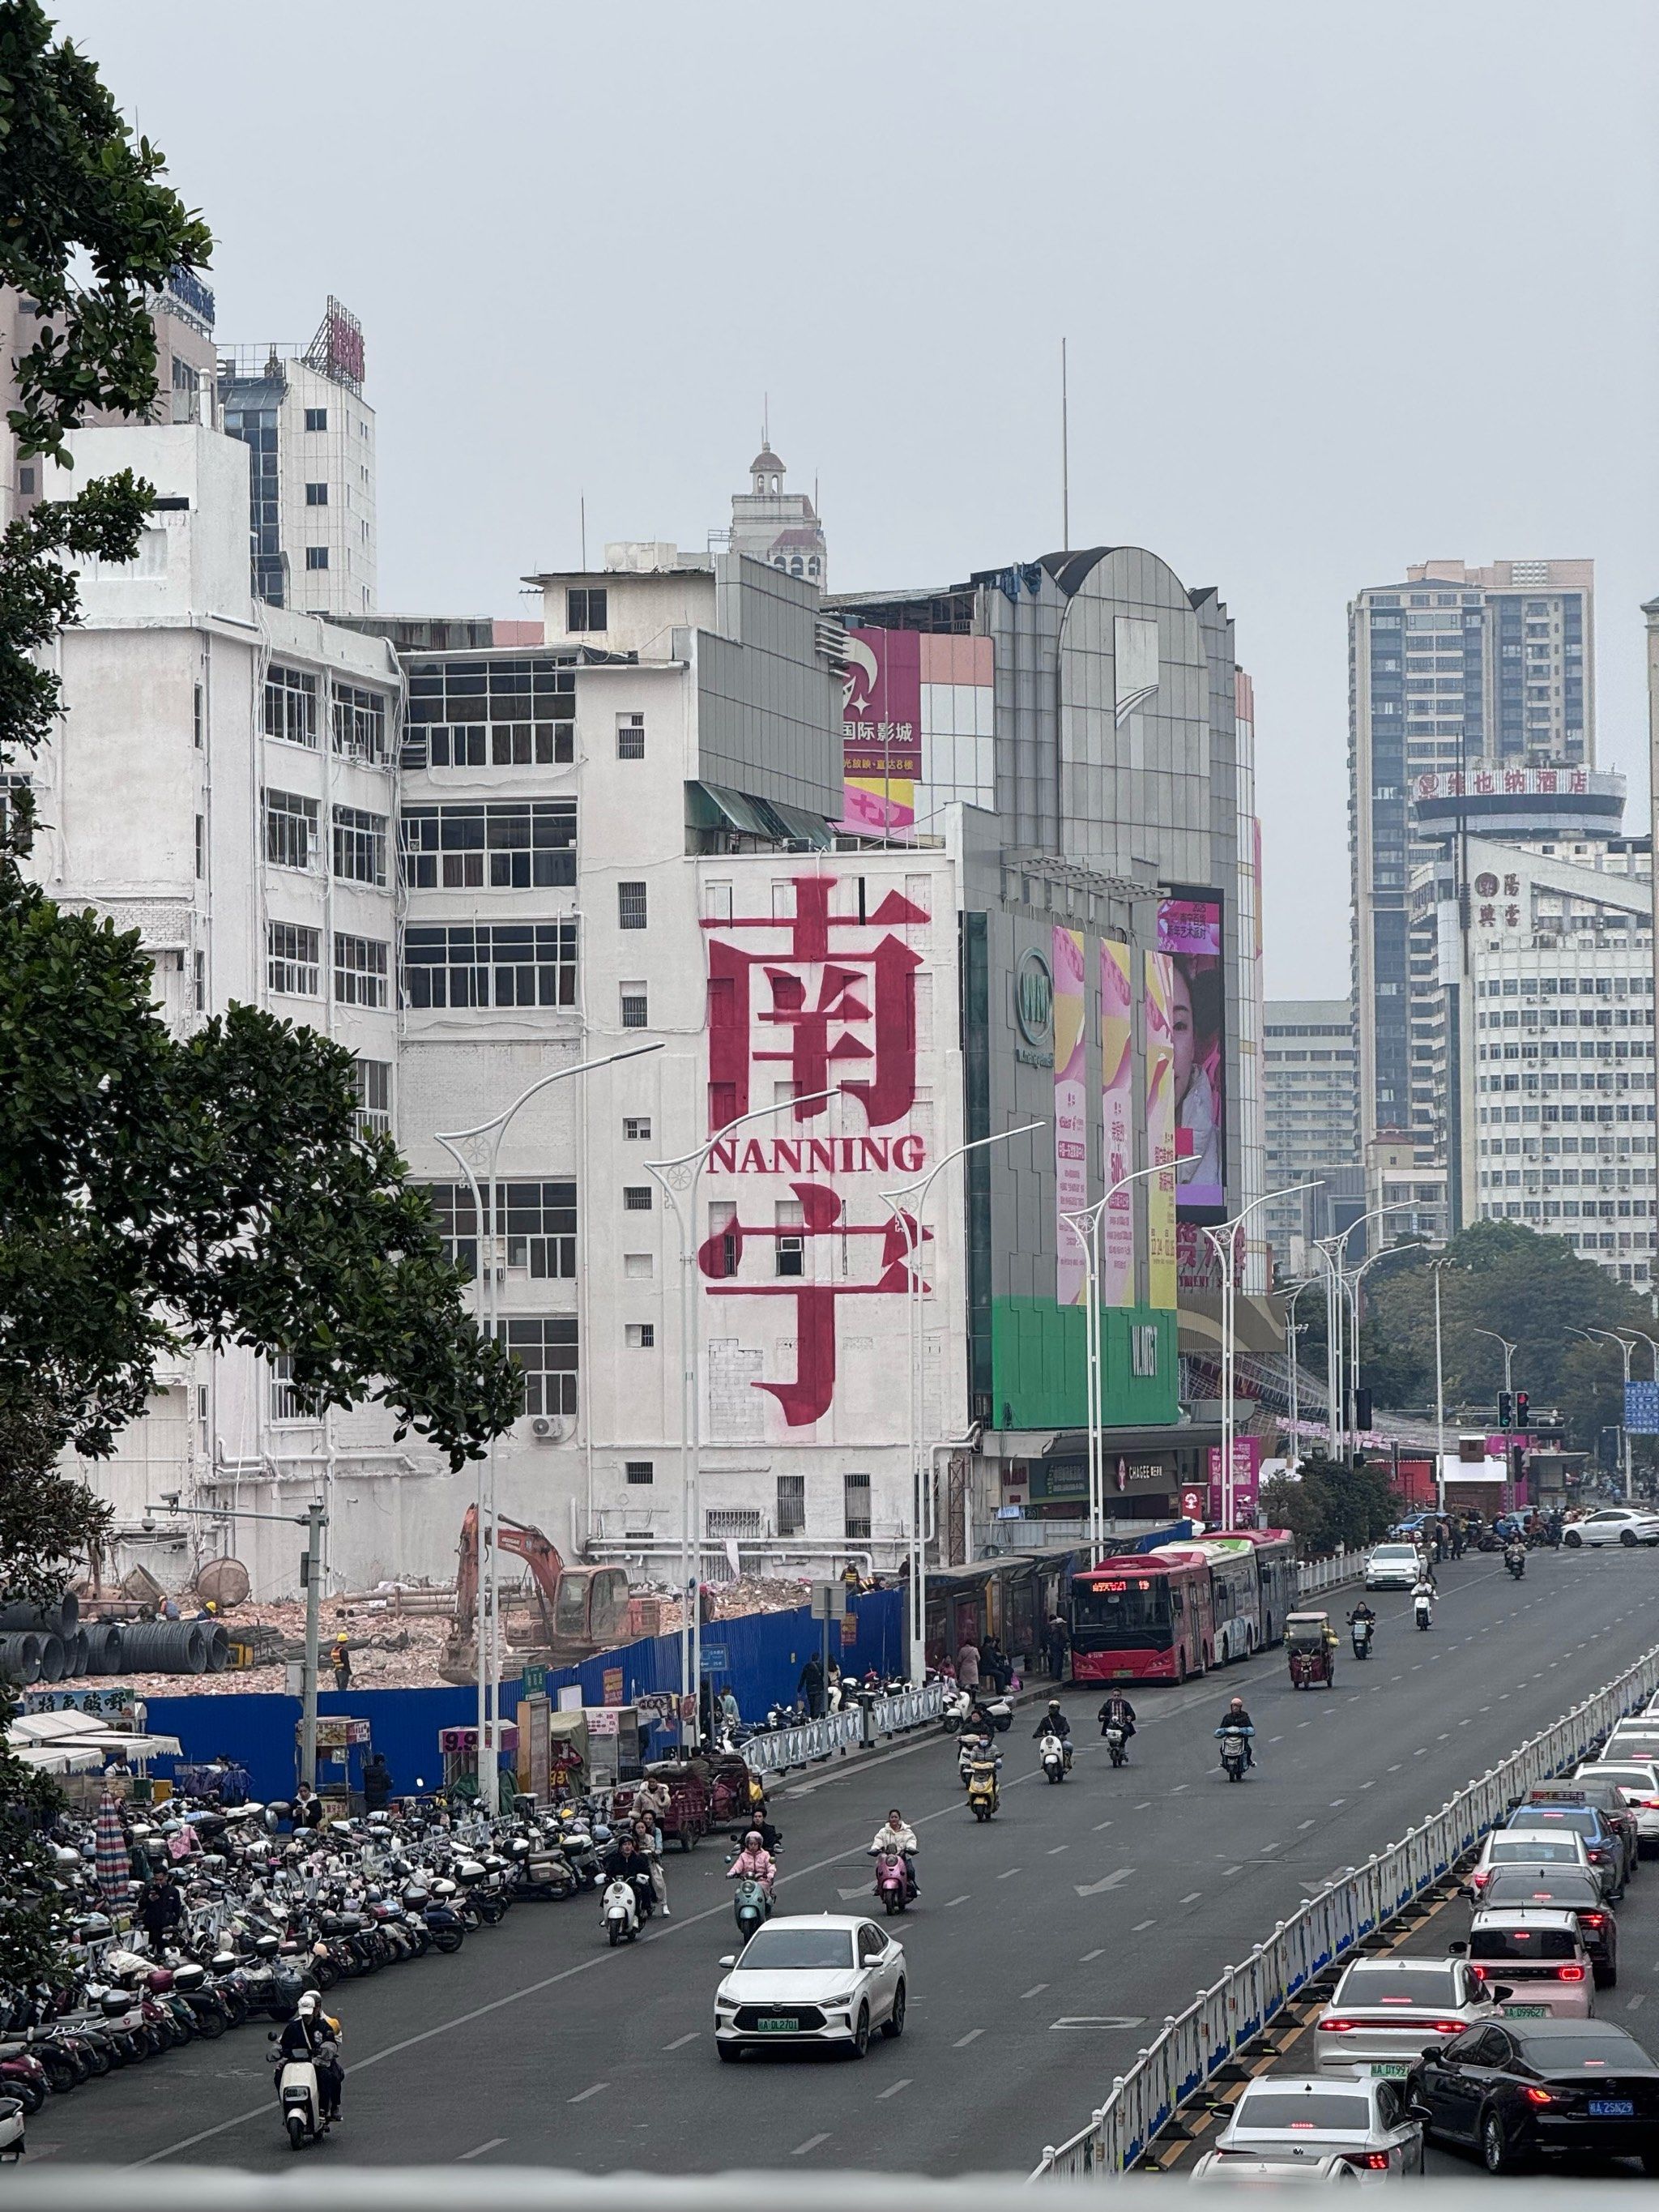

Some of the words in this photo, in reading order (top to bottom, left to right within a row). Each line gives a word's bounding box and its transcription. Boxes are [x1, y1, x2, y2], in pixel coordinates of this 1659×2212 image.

[842, 720, 914, 743] 国际影城
[1447, 770, 1588, 796] 维也纳酒店
[706, 1134, 926, 1174] NANNING
[697, 1182, 935, 1428] 宁
[1128, 1465, 1150, 1480] CHAGEE
